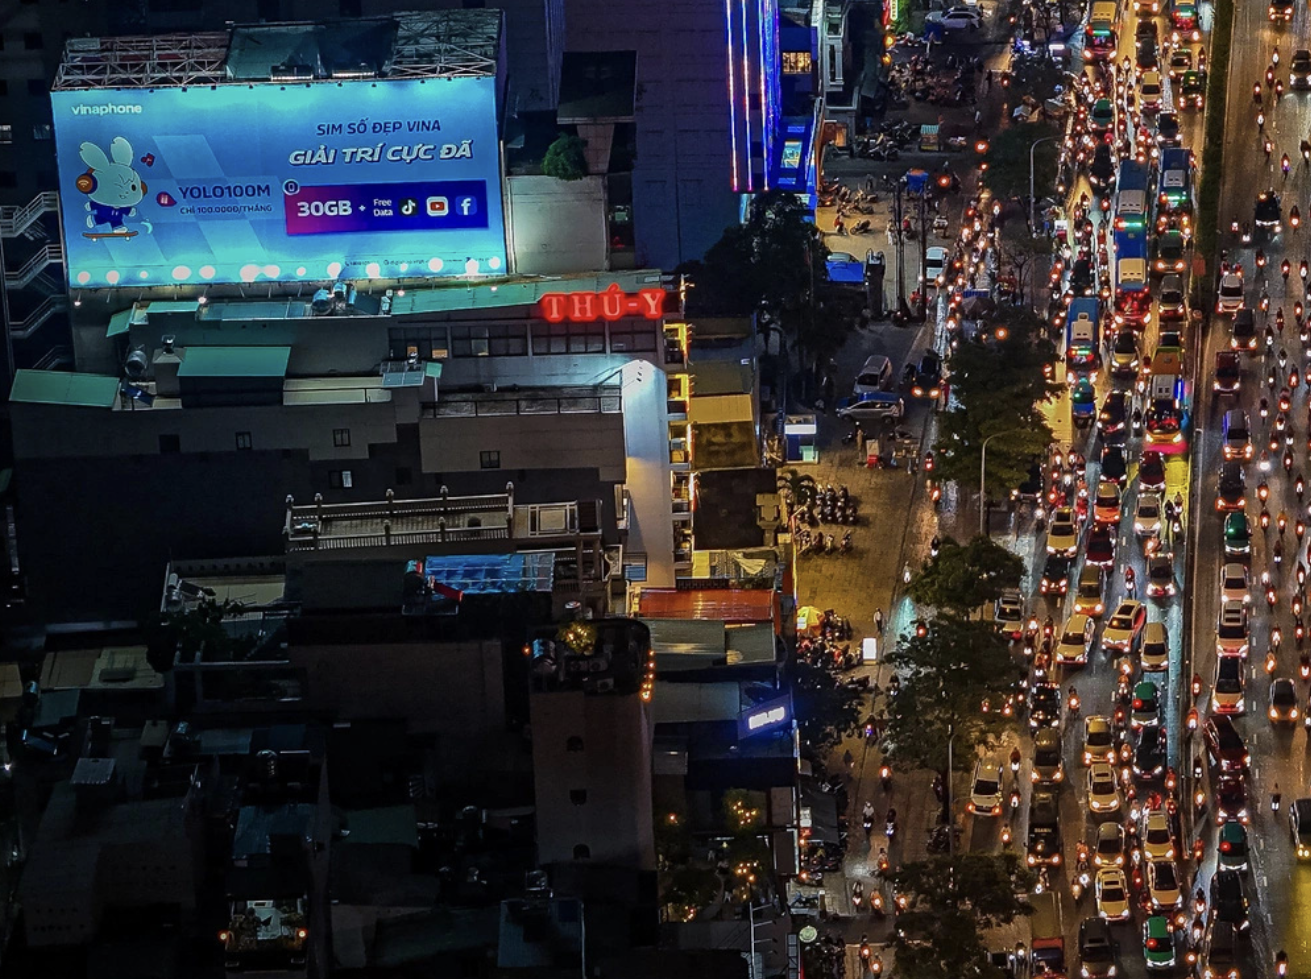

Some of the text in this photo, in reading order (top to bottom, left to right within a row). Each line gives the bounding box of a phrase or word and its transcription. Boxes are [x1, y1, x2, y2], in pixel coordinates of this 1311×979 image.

[71, 102, 143, 116] vinaphone
[316, 118, 441, 136] SIM SỐ ĐẸP VINA
[289, 139, 474, 165] GIẢI TRÍ CỰC ĐÃ
[178, 184, 271, 200] YOLO100M
[297, 199, 353, 217] 30GB
[373, 199, 392, 207] Free
[373, 208, 393, 217] Data
